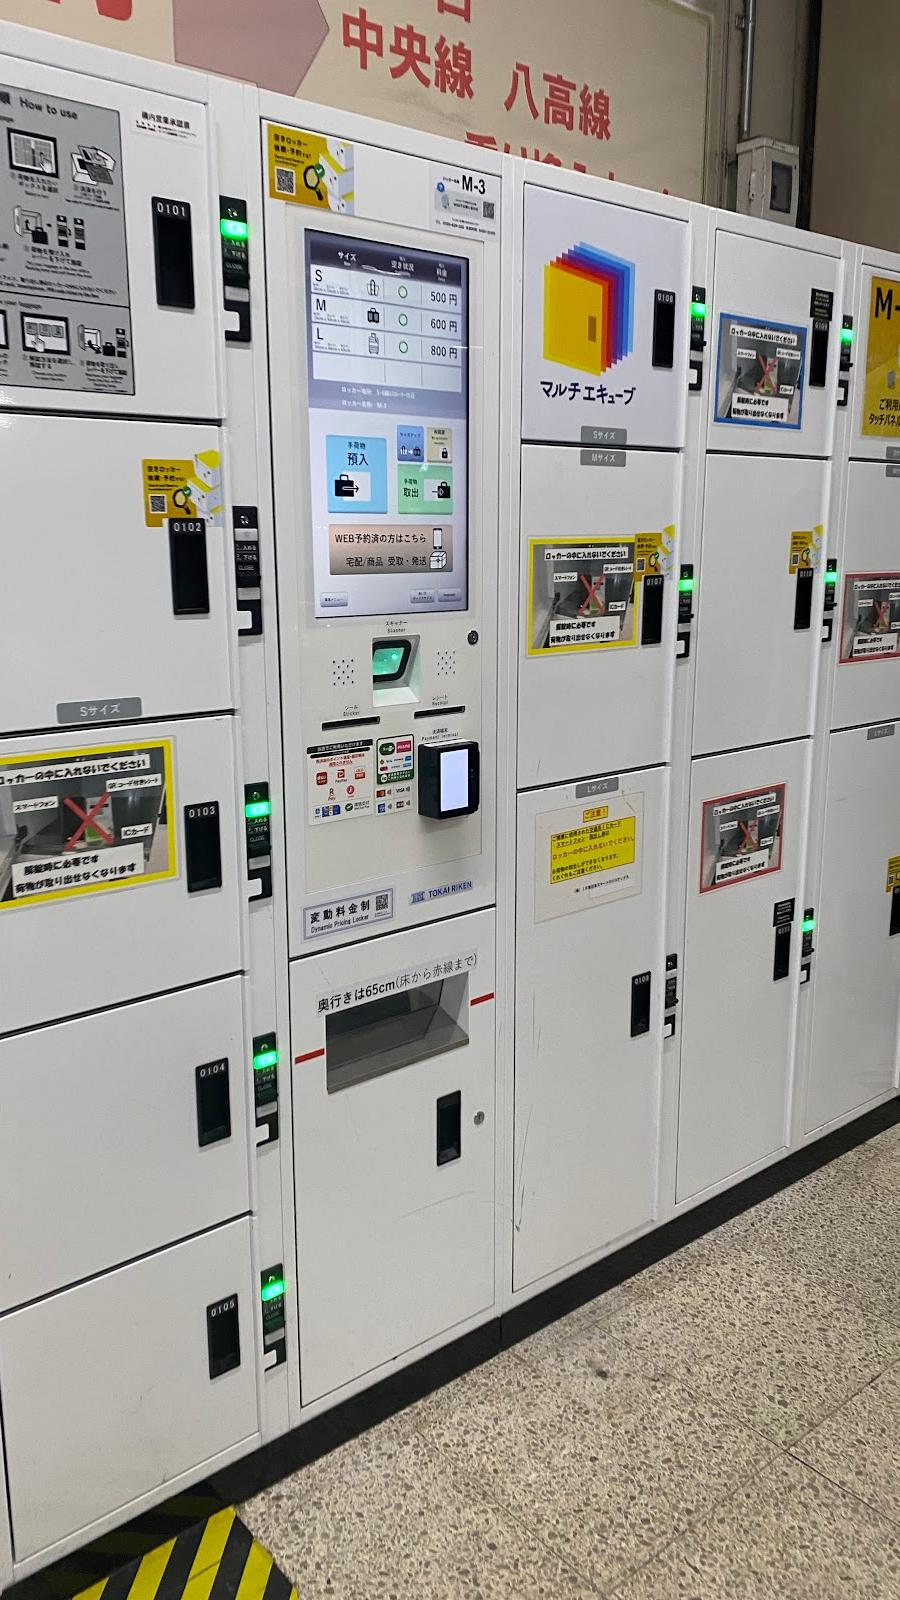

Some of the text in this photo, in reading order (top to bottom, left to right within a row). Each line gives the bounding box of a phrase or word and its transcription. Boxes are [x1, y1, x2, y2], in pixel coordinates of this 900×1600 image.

[342, 8, 612, 141] 中央線 八高線
[46, 104, 58, 115] to
[462, 174, 486, 195] M-3
[157, 203, 186, 217] 0101
[338, 251, 357, 262] サイズ
[315, 269, 323, 282] S
[316, 298, 326, 311] M
[430, 291, 458, 306] 500 円
[430, 318, 458, 333] 600 円
[316, 328, 324, 340] L
[430, 345, 447, 357] 800
[540, 381, 636, 405] マルチエキューブ
[593, 430, 616, 440] Sサイズ
[347, 452, 369, 466] 預入
[403, 487, 419, 498] 取出
[173, 522, 202, 533] 0102
[335, 533, 427, 544] WEB予約済の方はこちら
[646, 577, 662, 586] 0107
[79, 703, 121, 717] Sサイズ
[188, 805, 216, 818] 0103
[123, 825, 149, 837] ICカード
[428, 885, 450, 898] TOKAI
[450, 880, 472, 893] RIKEN
[310, 899, 371, 924] 変動料金制
[352, 914, 369, 925] Locker
[317, 952, 477, 1013] 奥行きは65cm(床から赤線まで)
[200, 1062, 225, 1078] 0104
[211, 1299, 235, 1317] 0105
